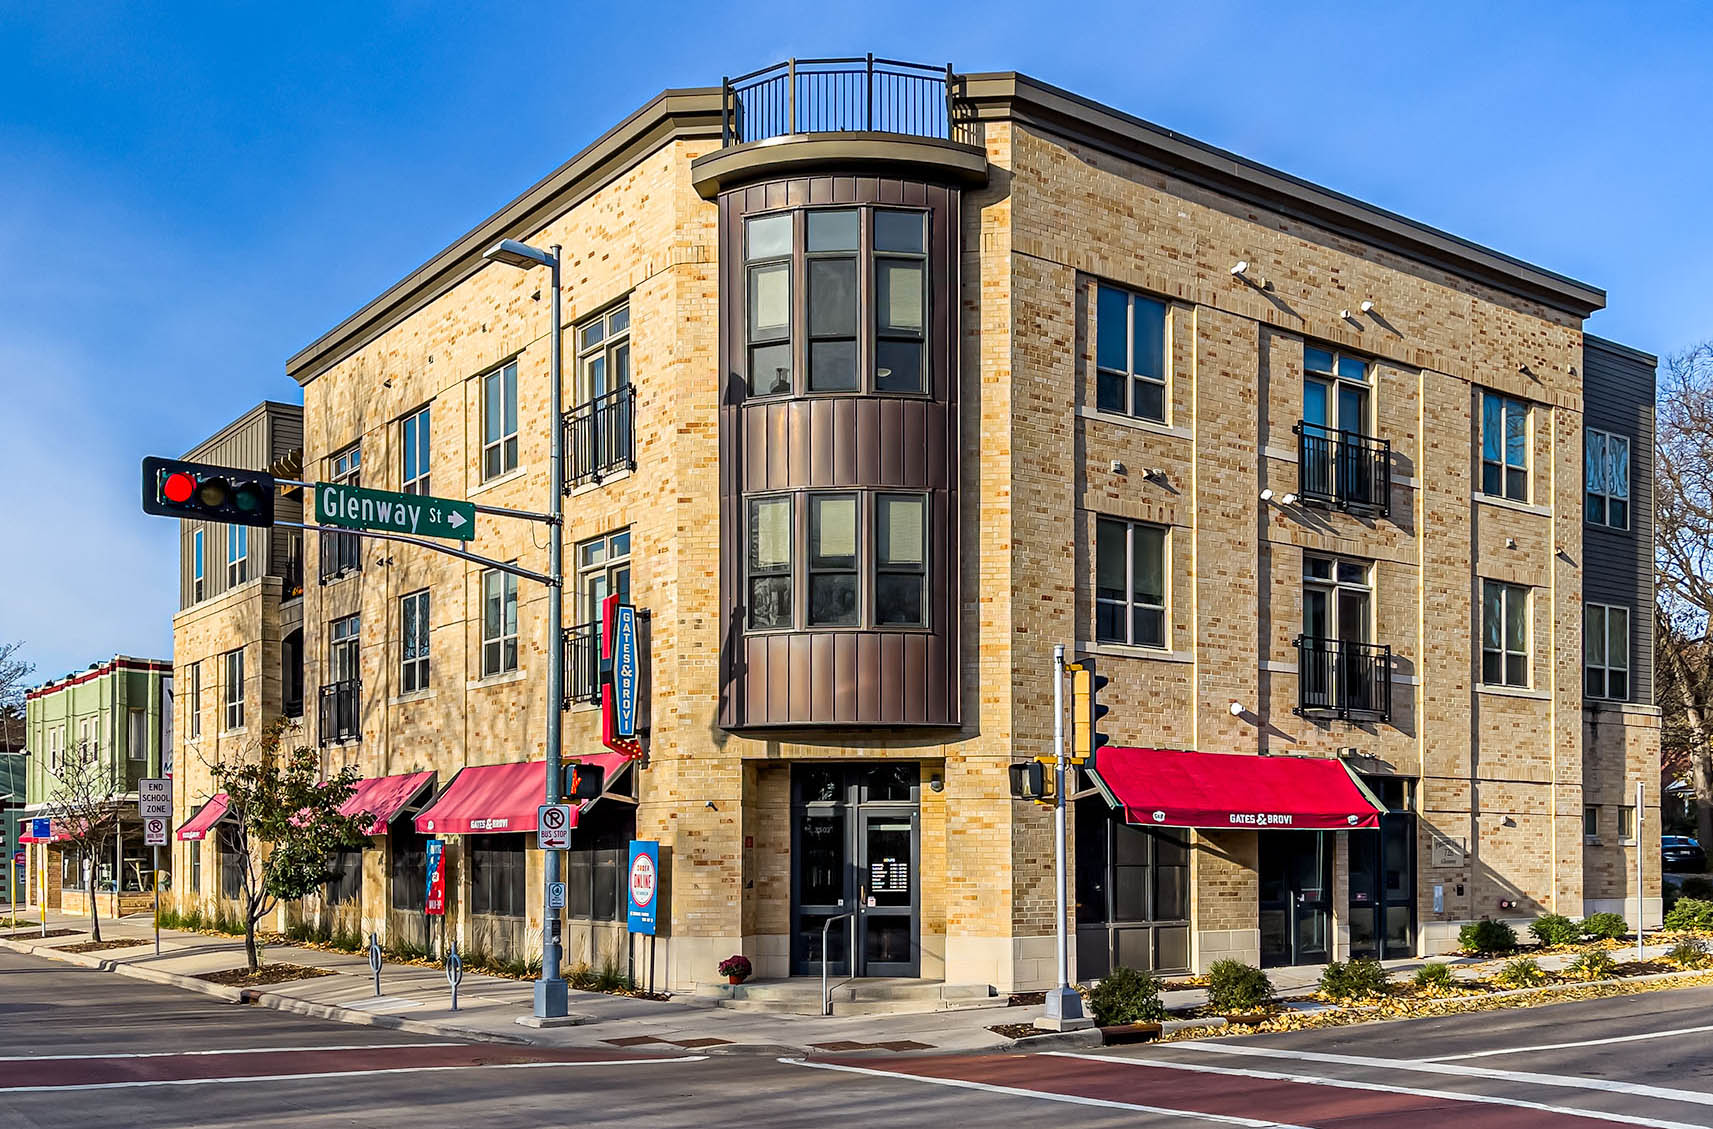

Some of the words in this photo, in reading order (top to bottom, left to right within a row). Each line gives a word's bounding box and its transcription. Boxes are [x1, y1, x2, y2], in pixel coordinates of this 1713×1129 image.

[323, 487, 421, 534] Glenway
[429, 507, 442, 524] St
[148, 783, 164, 791] END
[142, 794, 171, 802] SCHOOL
[146, 805, 166, 813] ZONE
[541, 830, 552, 838] BUS
[553, 830, 567, 838] STOP
